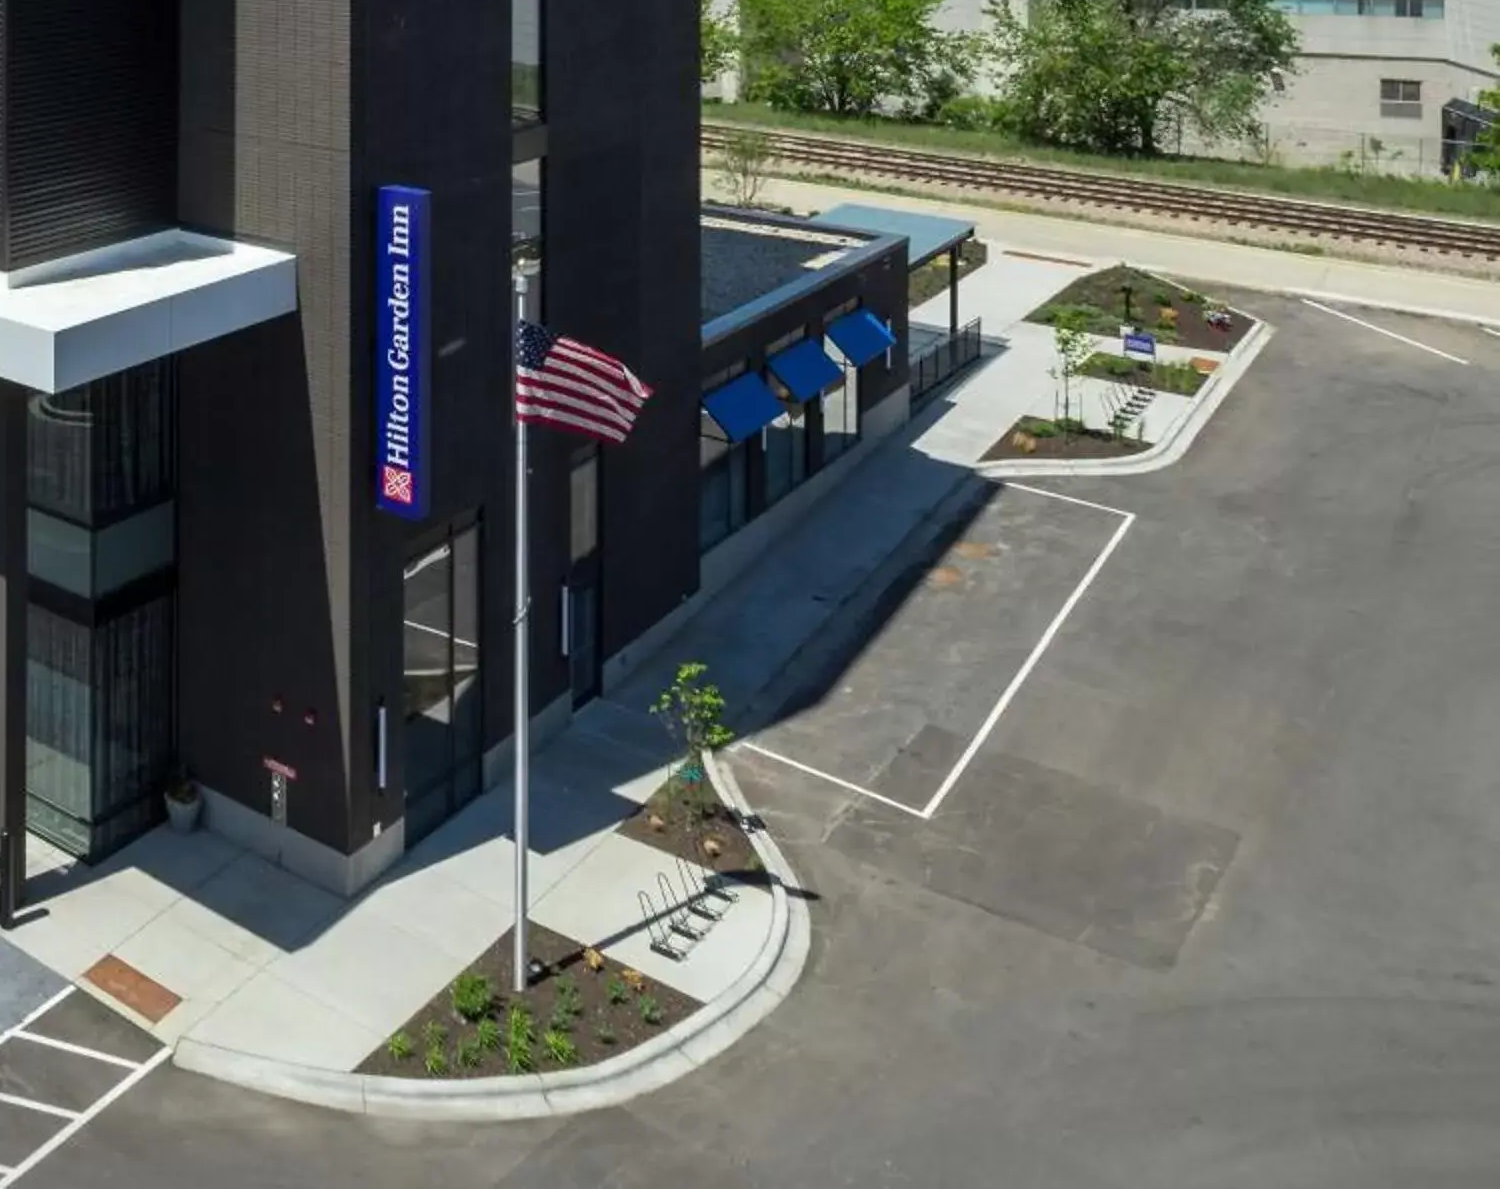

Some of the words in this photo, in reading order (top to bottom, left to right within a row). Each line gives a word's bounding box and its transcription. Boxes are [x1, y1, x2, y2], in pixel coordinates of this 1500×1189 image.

[388, 206, 409, 258] Inn
[388, 264, 409, 370] Garden
[387, 375, 409, 469] Hilton
